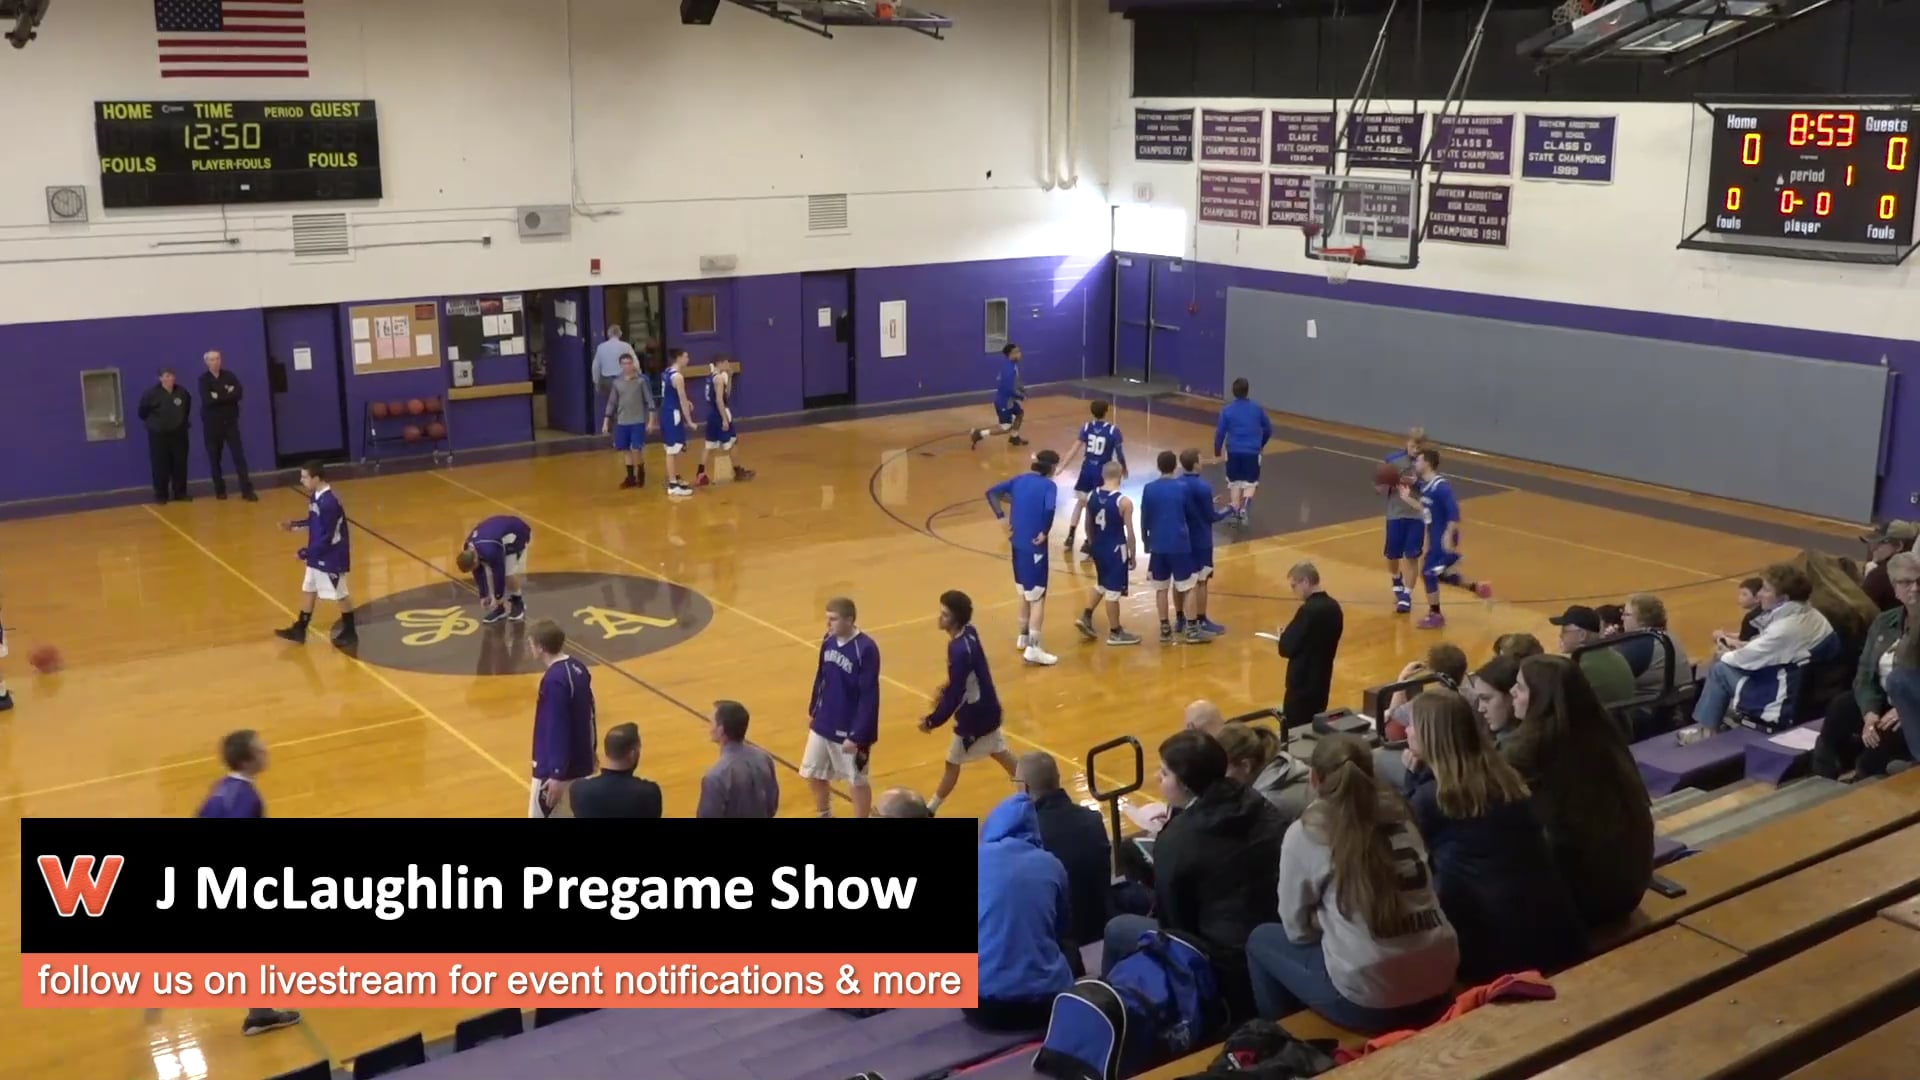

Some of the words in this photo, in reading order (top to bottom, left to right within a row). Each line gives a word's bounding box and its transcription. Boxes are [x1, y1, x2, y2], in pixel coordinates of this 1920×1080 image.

[103, 104, 153, 119] HOME
[194, 103, 233, 118] TIME
[264, 106, 304, 118] PERIOD
[310, 102, 361, 117] GUEST
[1727, 114, 1758, 129] Home
[1865, 116, 1908, 132] Guests
[184, 123, 261, 150] 12:50
[1789, 113, 1855, 147] 8:53
[1364, 135, 1392, 144] CLASS
[1544, 141, 1580, 151] CLASS
[1584, 142, 1592, 151] D
[1462, 151, 1505, 160] CHAMPIONS
[1743, 133, 1761, 165] 0
[1887, 137, 1908, 170] 0
[101, 157, 157, 173] FOULS
[308, 152, 358, 168] FOULS
[1529, 153, 1557, 162] STATE
[1558, 154, 1606, 164] CHAMPIONS
[1552, 165, 1579, 176] 1999
[1789, 169, 1826, 184] period
[1846, 165, 1853, 186] 1
[1727, 187, 1741, 210] 0
[1816, 191, 1831, 216] 0
[1879, 195, 1895, 220] 0
[1478, 215, 1498, 225] CLASS
[1717, 214, 1741, 230] fouls
[1784, 219, 1821, 235] player
[1433, 225, 1479, 238] CHAMPIONS
[1482, 229, 1501, 240] 1991
[1867, 225, 1896, 240] fouls
[1087, 434, 1106, 455] 30
[1095, 508, 1107, 531] 4
